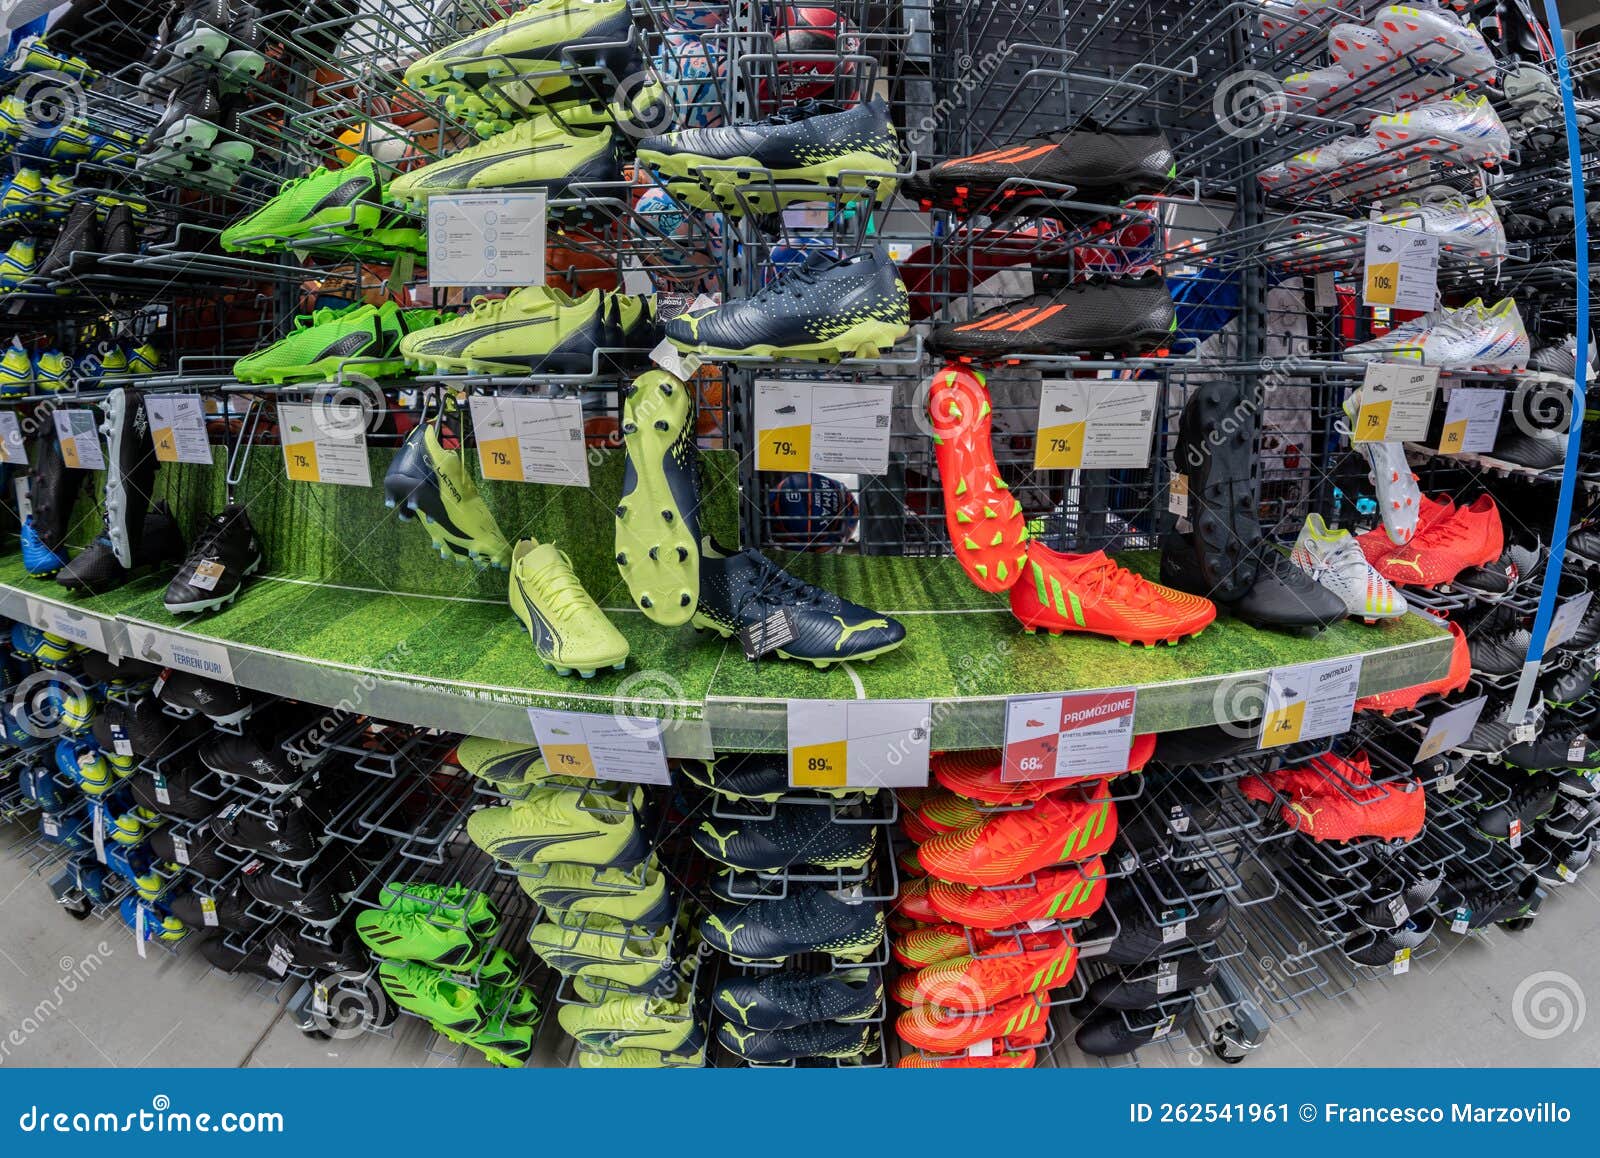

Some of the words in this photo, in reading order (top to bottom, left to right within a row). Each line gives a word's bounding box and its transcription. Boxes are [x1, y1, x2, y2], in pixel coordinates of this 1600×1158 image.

[436, 466, 462, 503] ULTRA
[1320, 664, 1353, 682] CONTROLLO
[1063, 699, 1132, 724] PROMOZIONE
